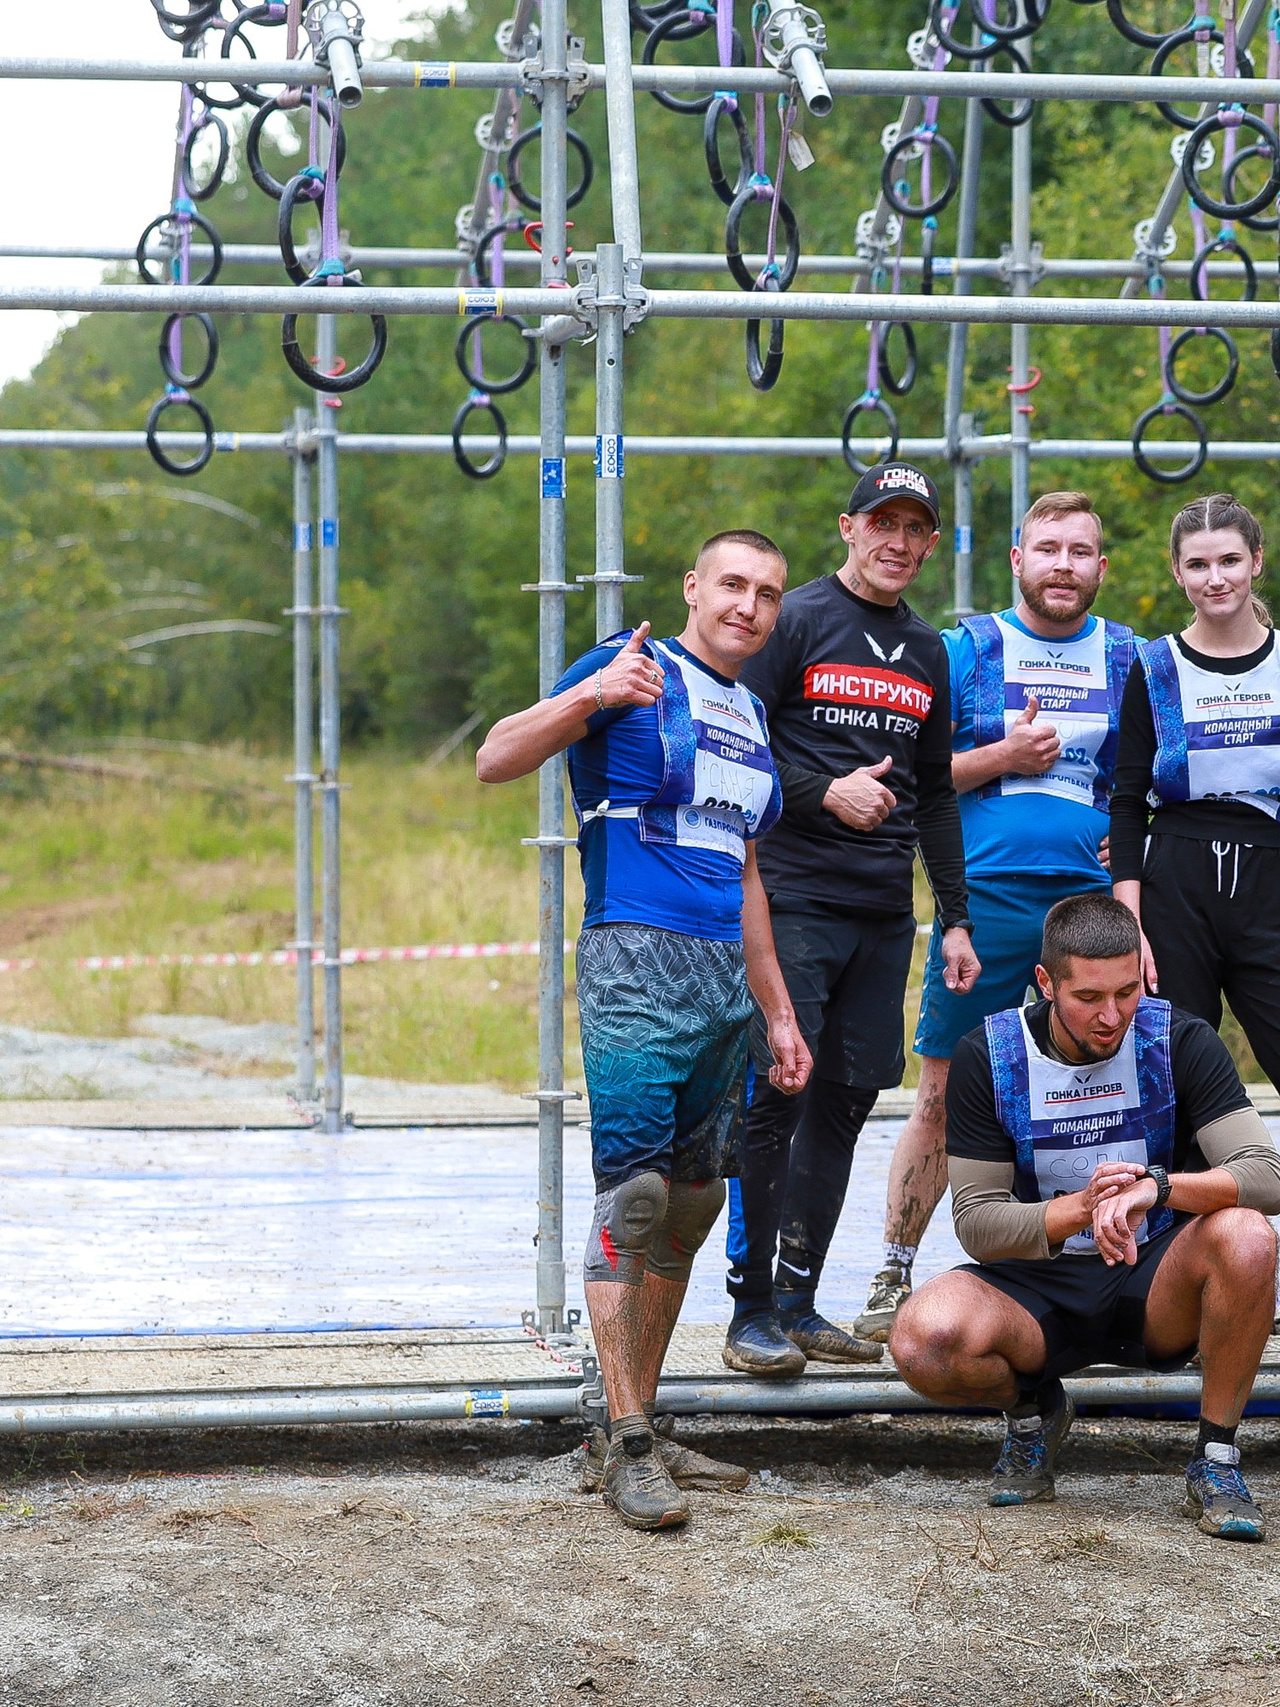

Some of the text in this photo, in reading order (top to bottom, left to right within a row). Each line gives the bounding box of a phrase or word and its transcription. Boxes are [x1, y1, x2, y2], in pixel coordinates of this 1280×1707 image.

[467, 296, 495, 304] СОЮЗ
[607, 438, 616, 473] СОЮЗ
[884, 468, 926, 487] ГОНКА
[880, 478, 930, 498] ГЕРОЕВ
[1019, 660, 1091, 674] ГОНКА ГЕРОЕВ
[1023, 686, 1089, 700] КОМАНДНЫЙ
[1196, 693, 1272, 706] ГОНКА ГЕРОЕВ
[702, 698, 731, 715] ГОНКА
[1040, 698, 1072, 709] СТАРТ
[813, 706, 879, 731] ГОНКА
[1204, 717, 1272, 735] КОМАНДНЫЙ
[706, 727, 756, 755] КОМАНДНЫЙ
[1224, 733, 1256, 745] СТАРТ
[720, 745, 745, 762] СТАРТ
[1045, 1082, 1123, 1101] ГОНКА ГЕРОЕВ
[1052, 1111, 1124, 1135] КОМАНДНЫЙ
[1072, 1130, 1106, 1145] СТАРТ
[474, 1401, 501, 1410] СОЮЗ
